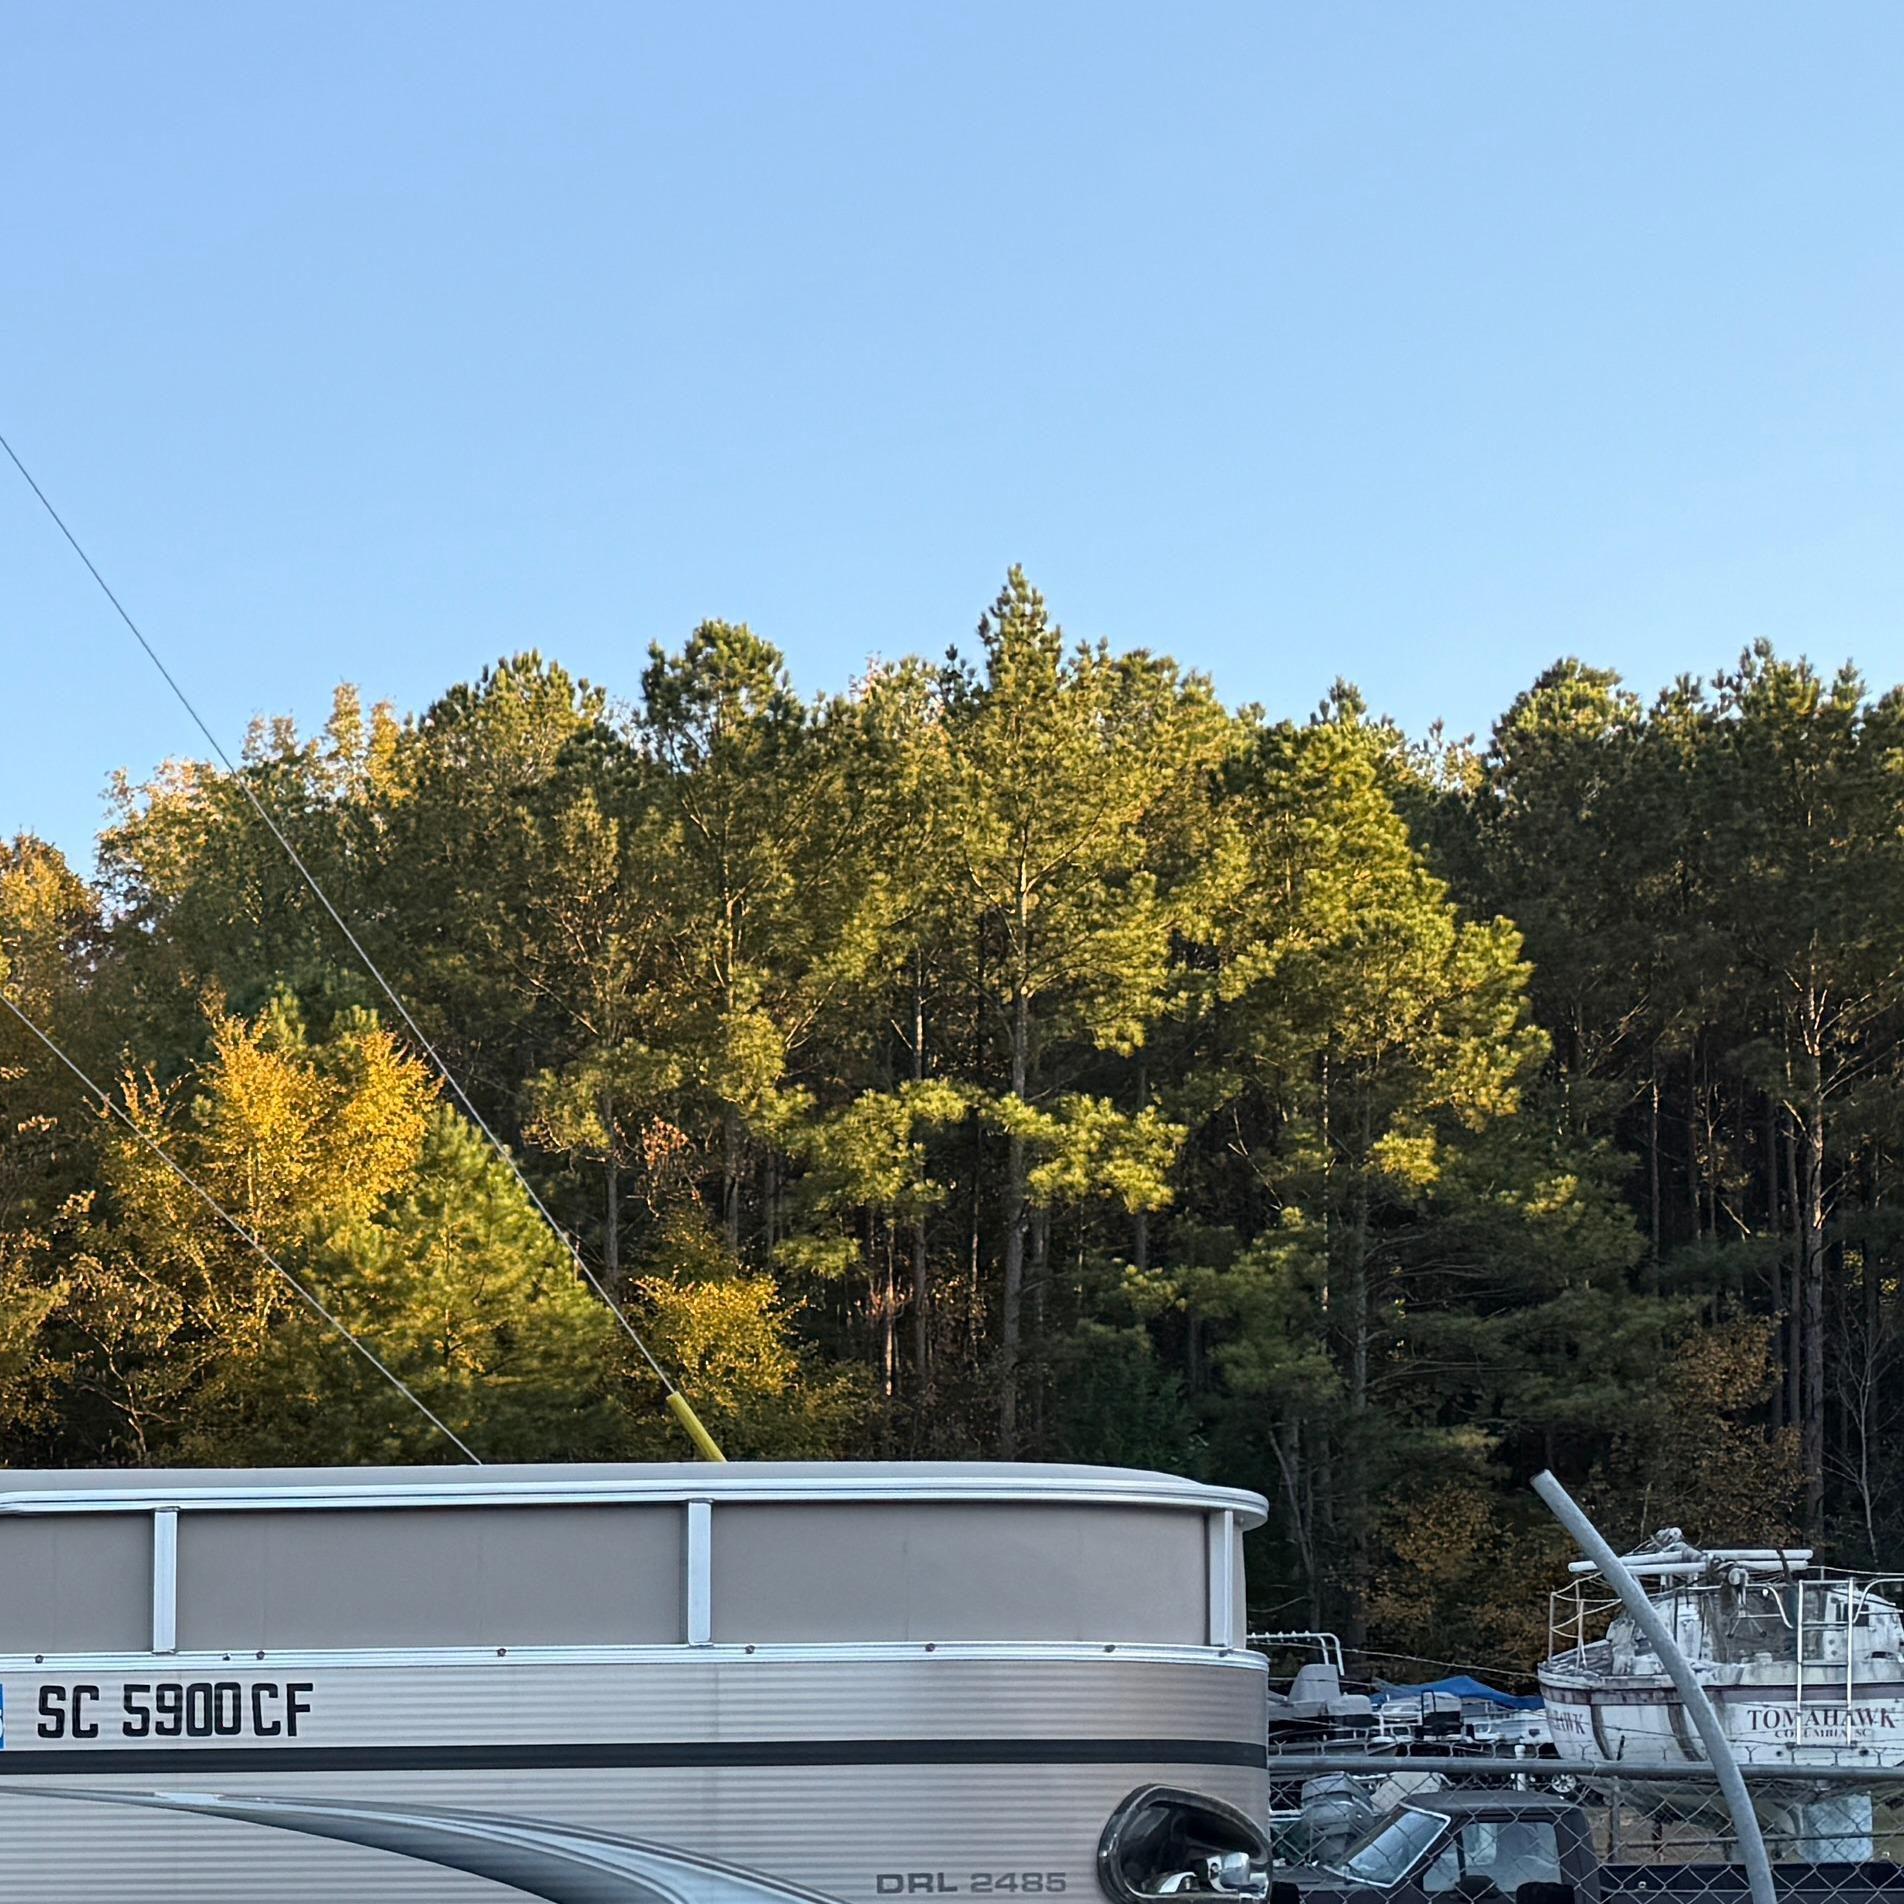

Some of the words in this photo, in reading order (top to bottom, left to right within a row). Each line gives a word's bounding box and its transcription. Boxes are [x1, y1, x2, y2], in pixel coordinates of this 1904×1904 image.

[37, 1684, 100, 1739] SC
[1747, 1707, 1897, 1731] TOMAHAWK
[1775, 1727, 1851, 1739] COUMBIA
[876, 1872, 959, 1894] DRL
[970, 1872, 1067, 1893] 2485
